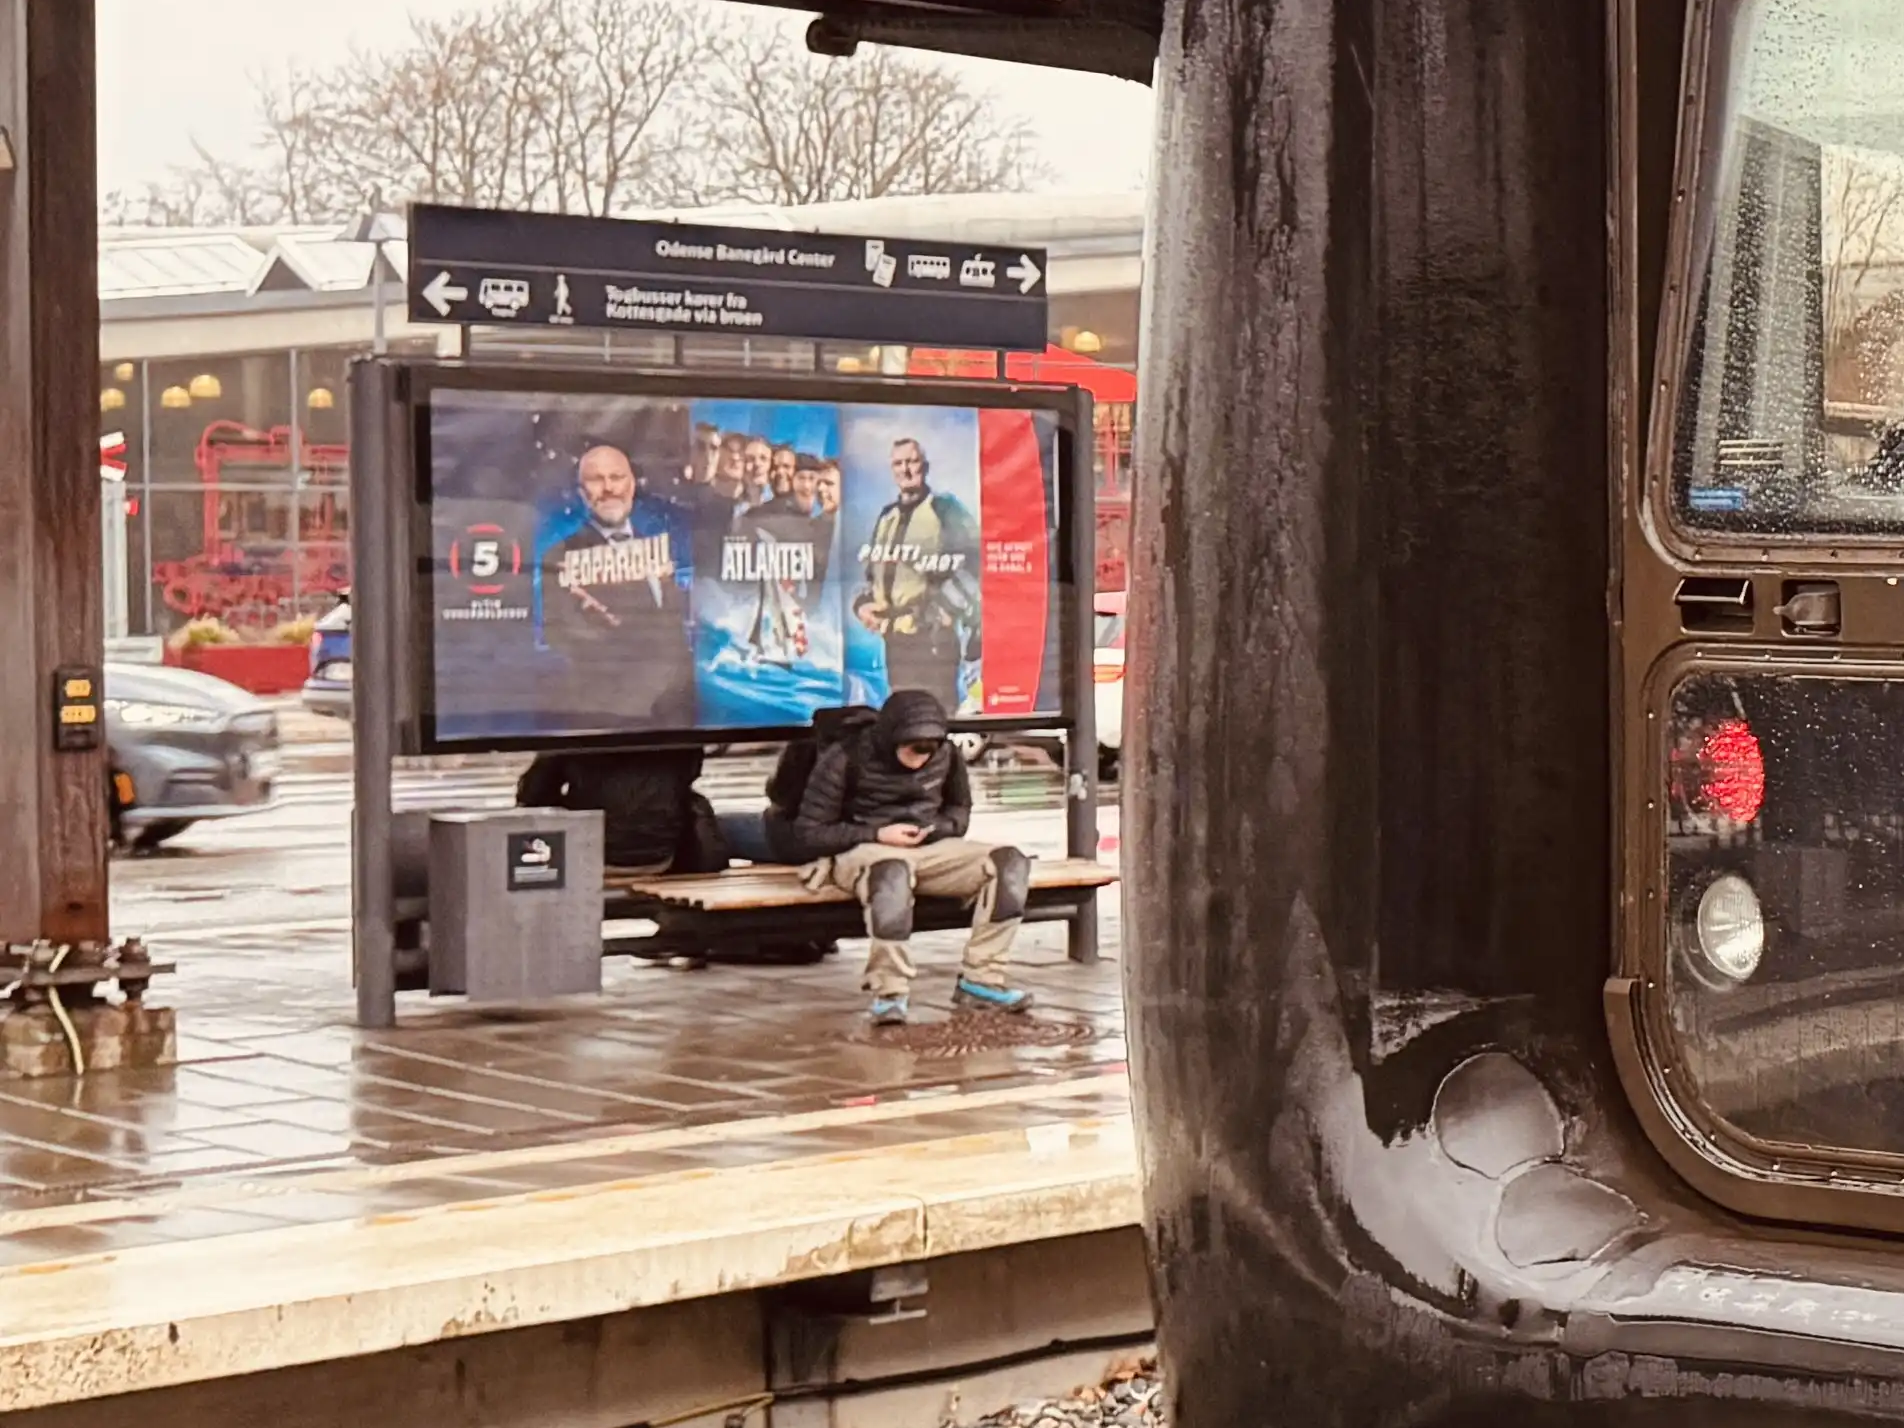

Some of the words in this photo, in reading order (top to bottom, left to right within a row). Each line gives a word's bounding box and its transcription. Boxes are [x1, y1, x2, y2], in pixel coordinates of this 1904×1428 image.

[655, 239, 713, 261] Odense
[789, 248, 836, 269] Center
[472, 541, 499, 577] 5
[721, 542, 814, 581] ATLANTEN
[857, 543, 919, 563] POLITI
